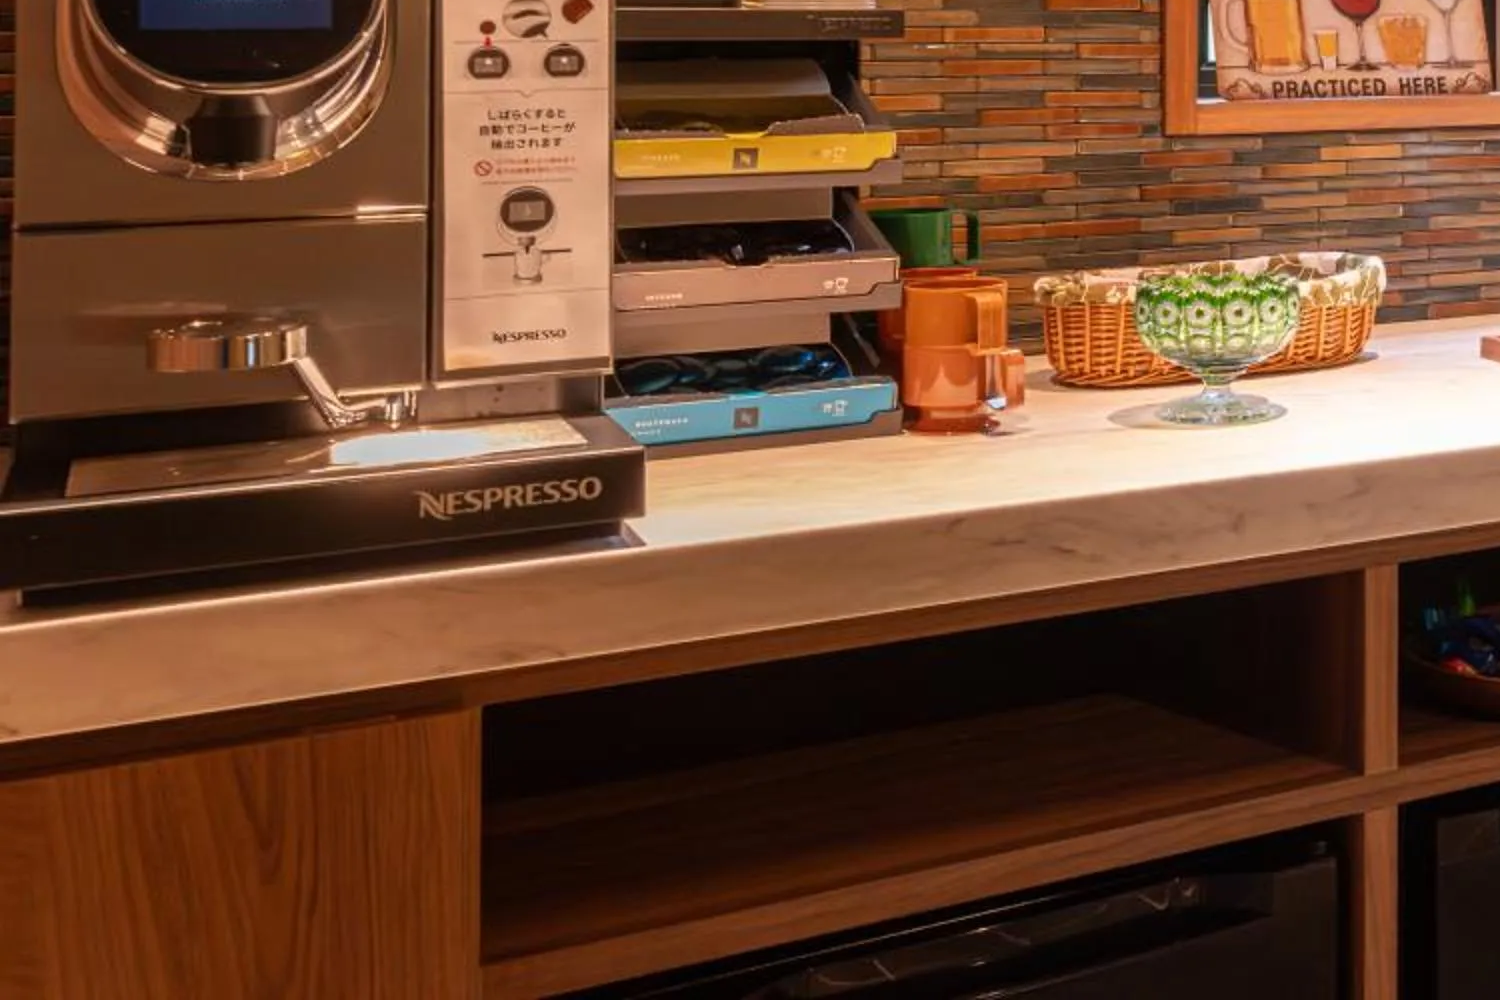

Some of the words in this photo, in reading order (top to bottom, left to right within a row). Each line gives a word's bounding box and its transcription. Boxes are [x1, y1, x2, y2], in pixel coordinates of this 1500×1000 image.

[1271, 77, 1386, 100] PRACTICED
[1399, 76, 1449, 96] HERE
[487, 108, 567, 120] しばらくすると
[479, 121, 576, 137] 自動でコーヒーが
[491, 137, 563, 150] 抽出されます
[492, 329, 567, 345] NESPRESSO
[414, 476, 603, 521] NESPRESSO
